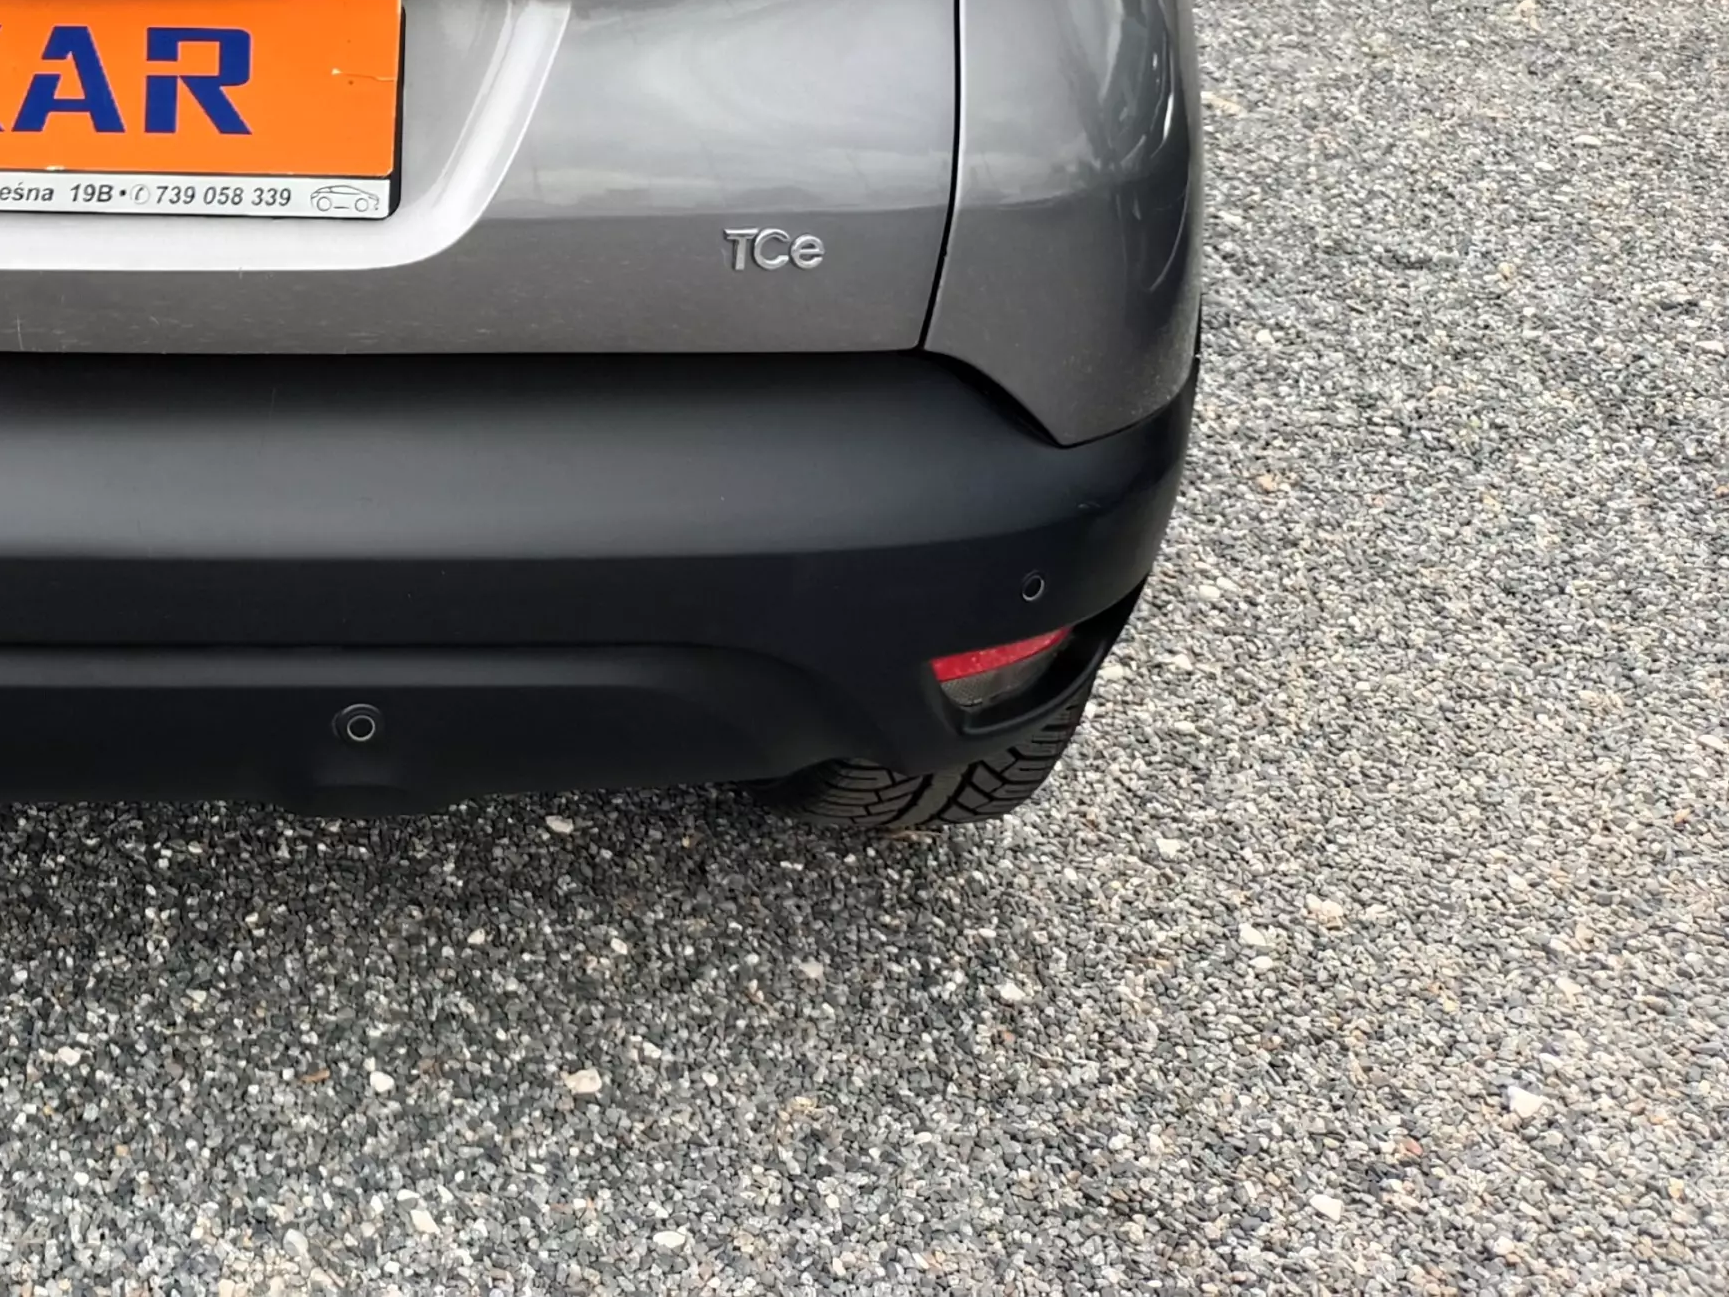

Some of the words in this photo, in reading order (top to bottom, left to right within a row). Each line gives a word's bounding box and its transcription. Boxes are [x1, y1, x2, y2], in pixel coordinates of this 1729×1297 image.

[155, 184, 196, 206] 739
[202, 184, 245, 207] 058
[250, 185, 293, 208] 339
[722, 226, 825, 271] TCe
